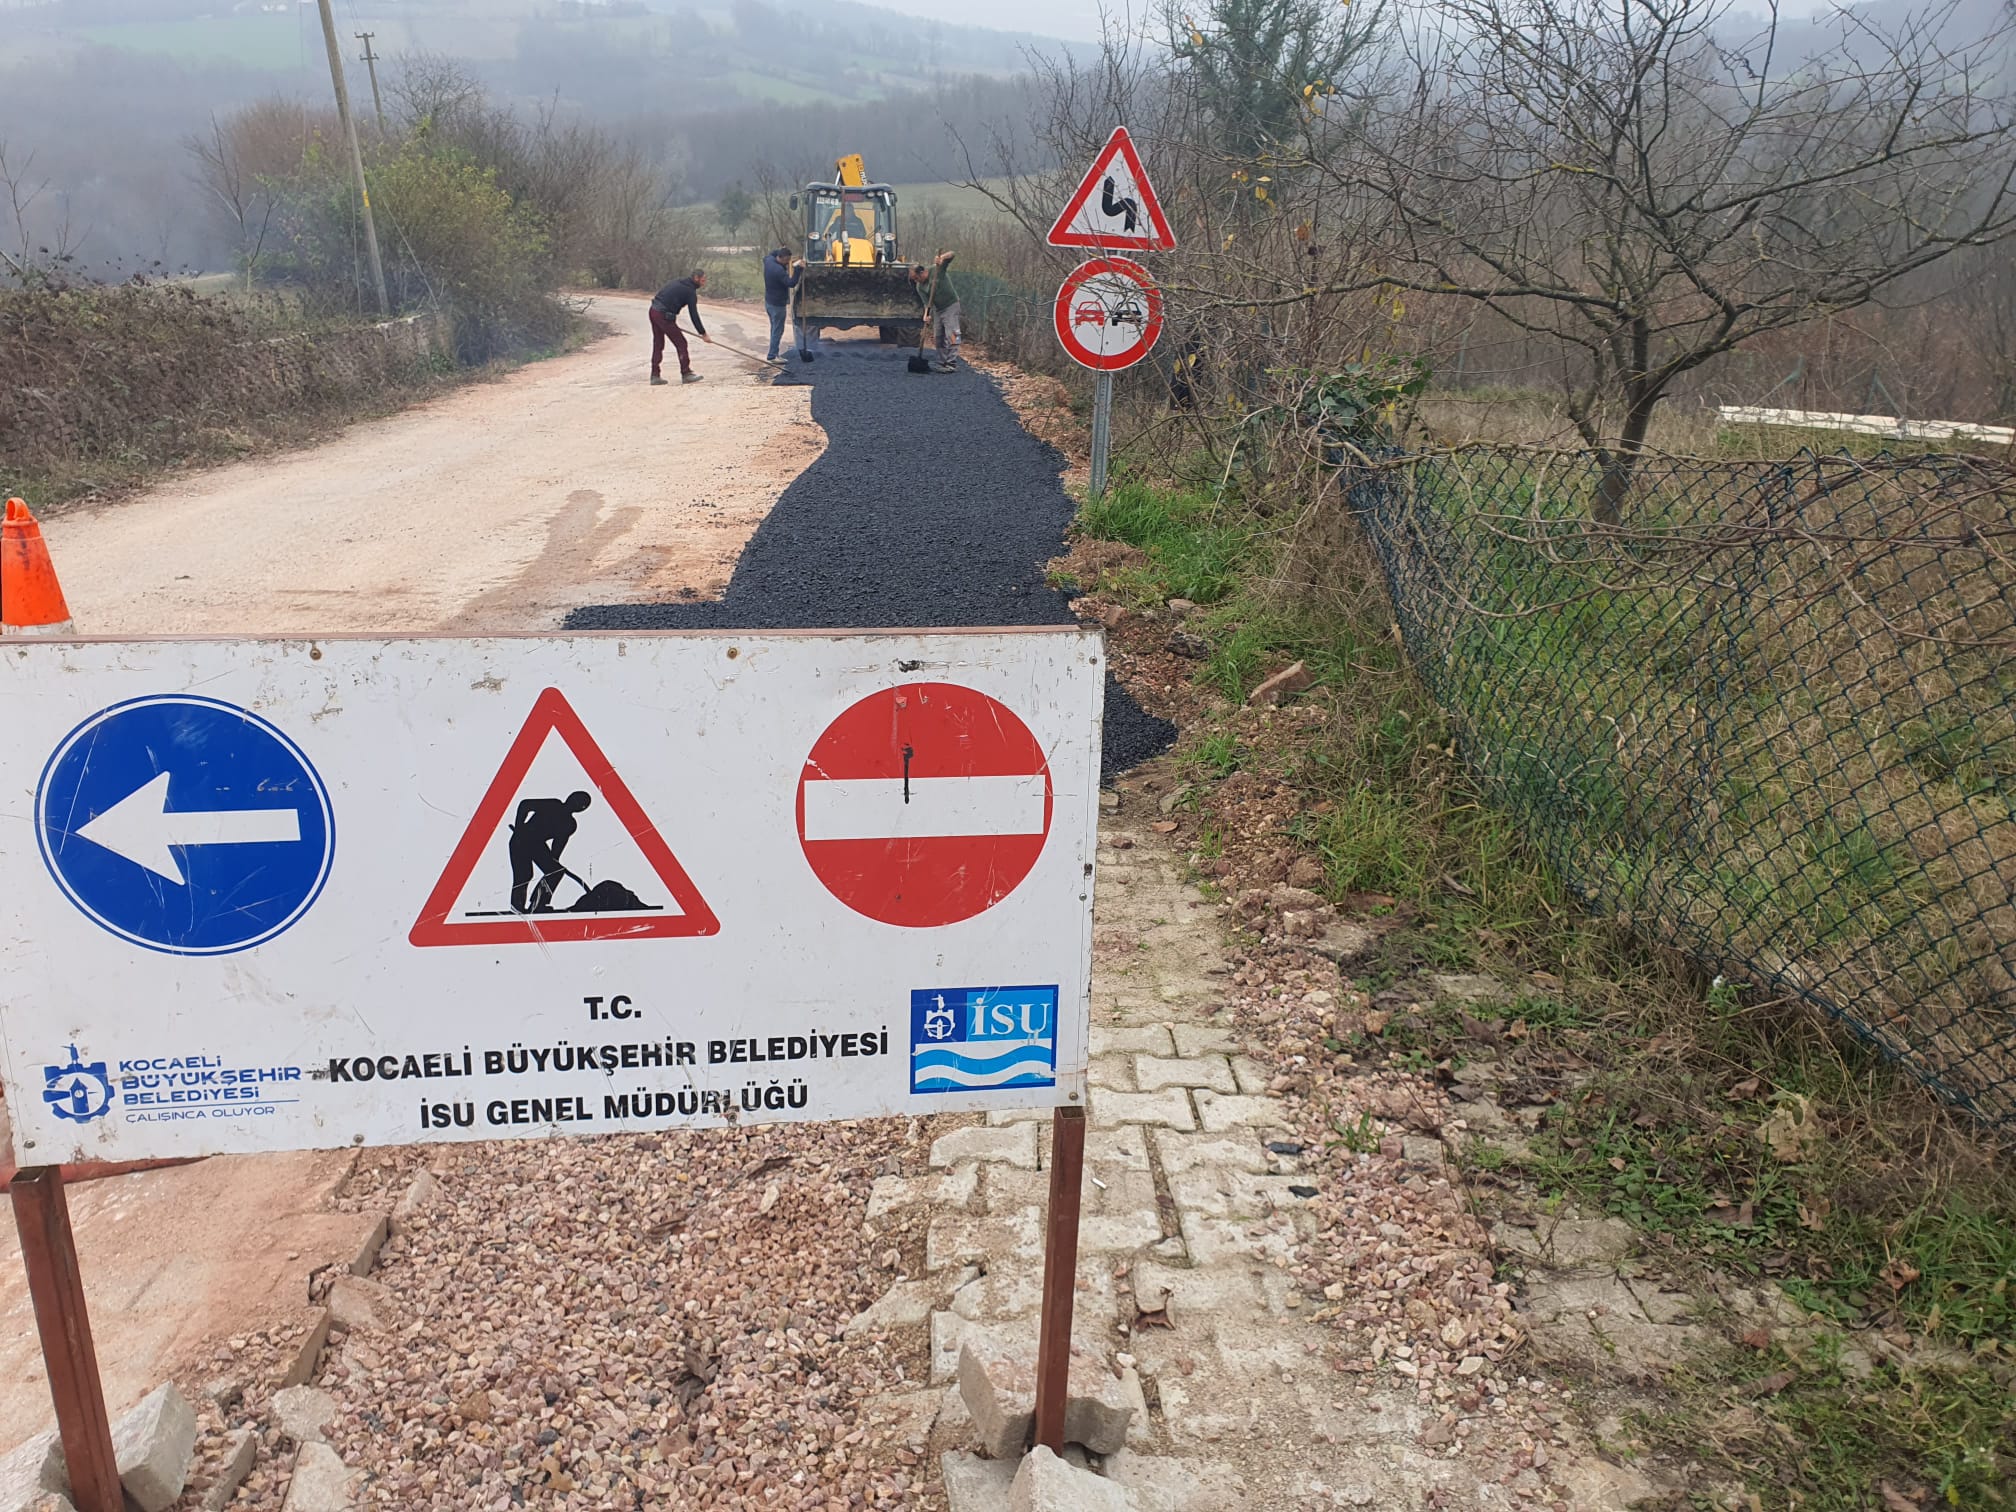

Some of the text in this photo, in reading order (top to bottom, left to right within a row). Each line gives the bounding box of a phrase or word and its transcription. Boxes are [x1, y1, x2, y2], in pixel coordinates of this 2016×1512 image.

[583, 994, 642, 1020] T.C.
[971, 997, 1052, 1035] İSU
[329, 1025, 888, 1083] KOCAELİ BÜYÜKŞEHİR BELEDİYESİ
[125, 1106, 275, 1123] ÇALIŞINCA OLUYOR
[420, 1078, 808, 1128] İSU GENEL MÜDÜRLÜĞÜ
